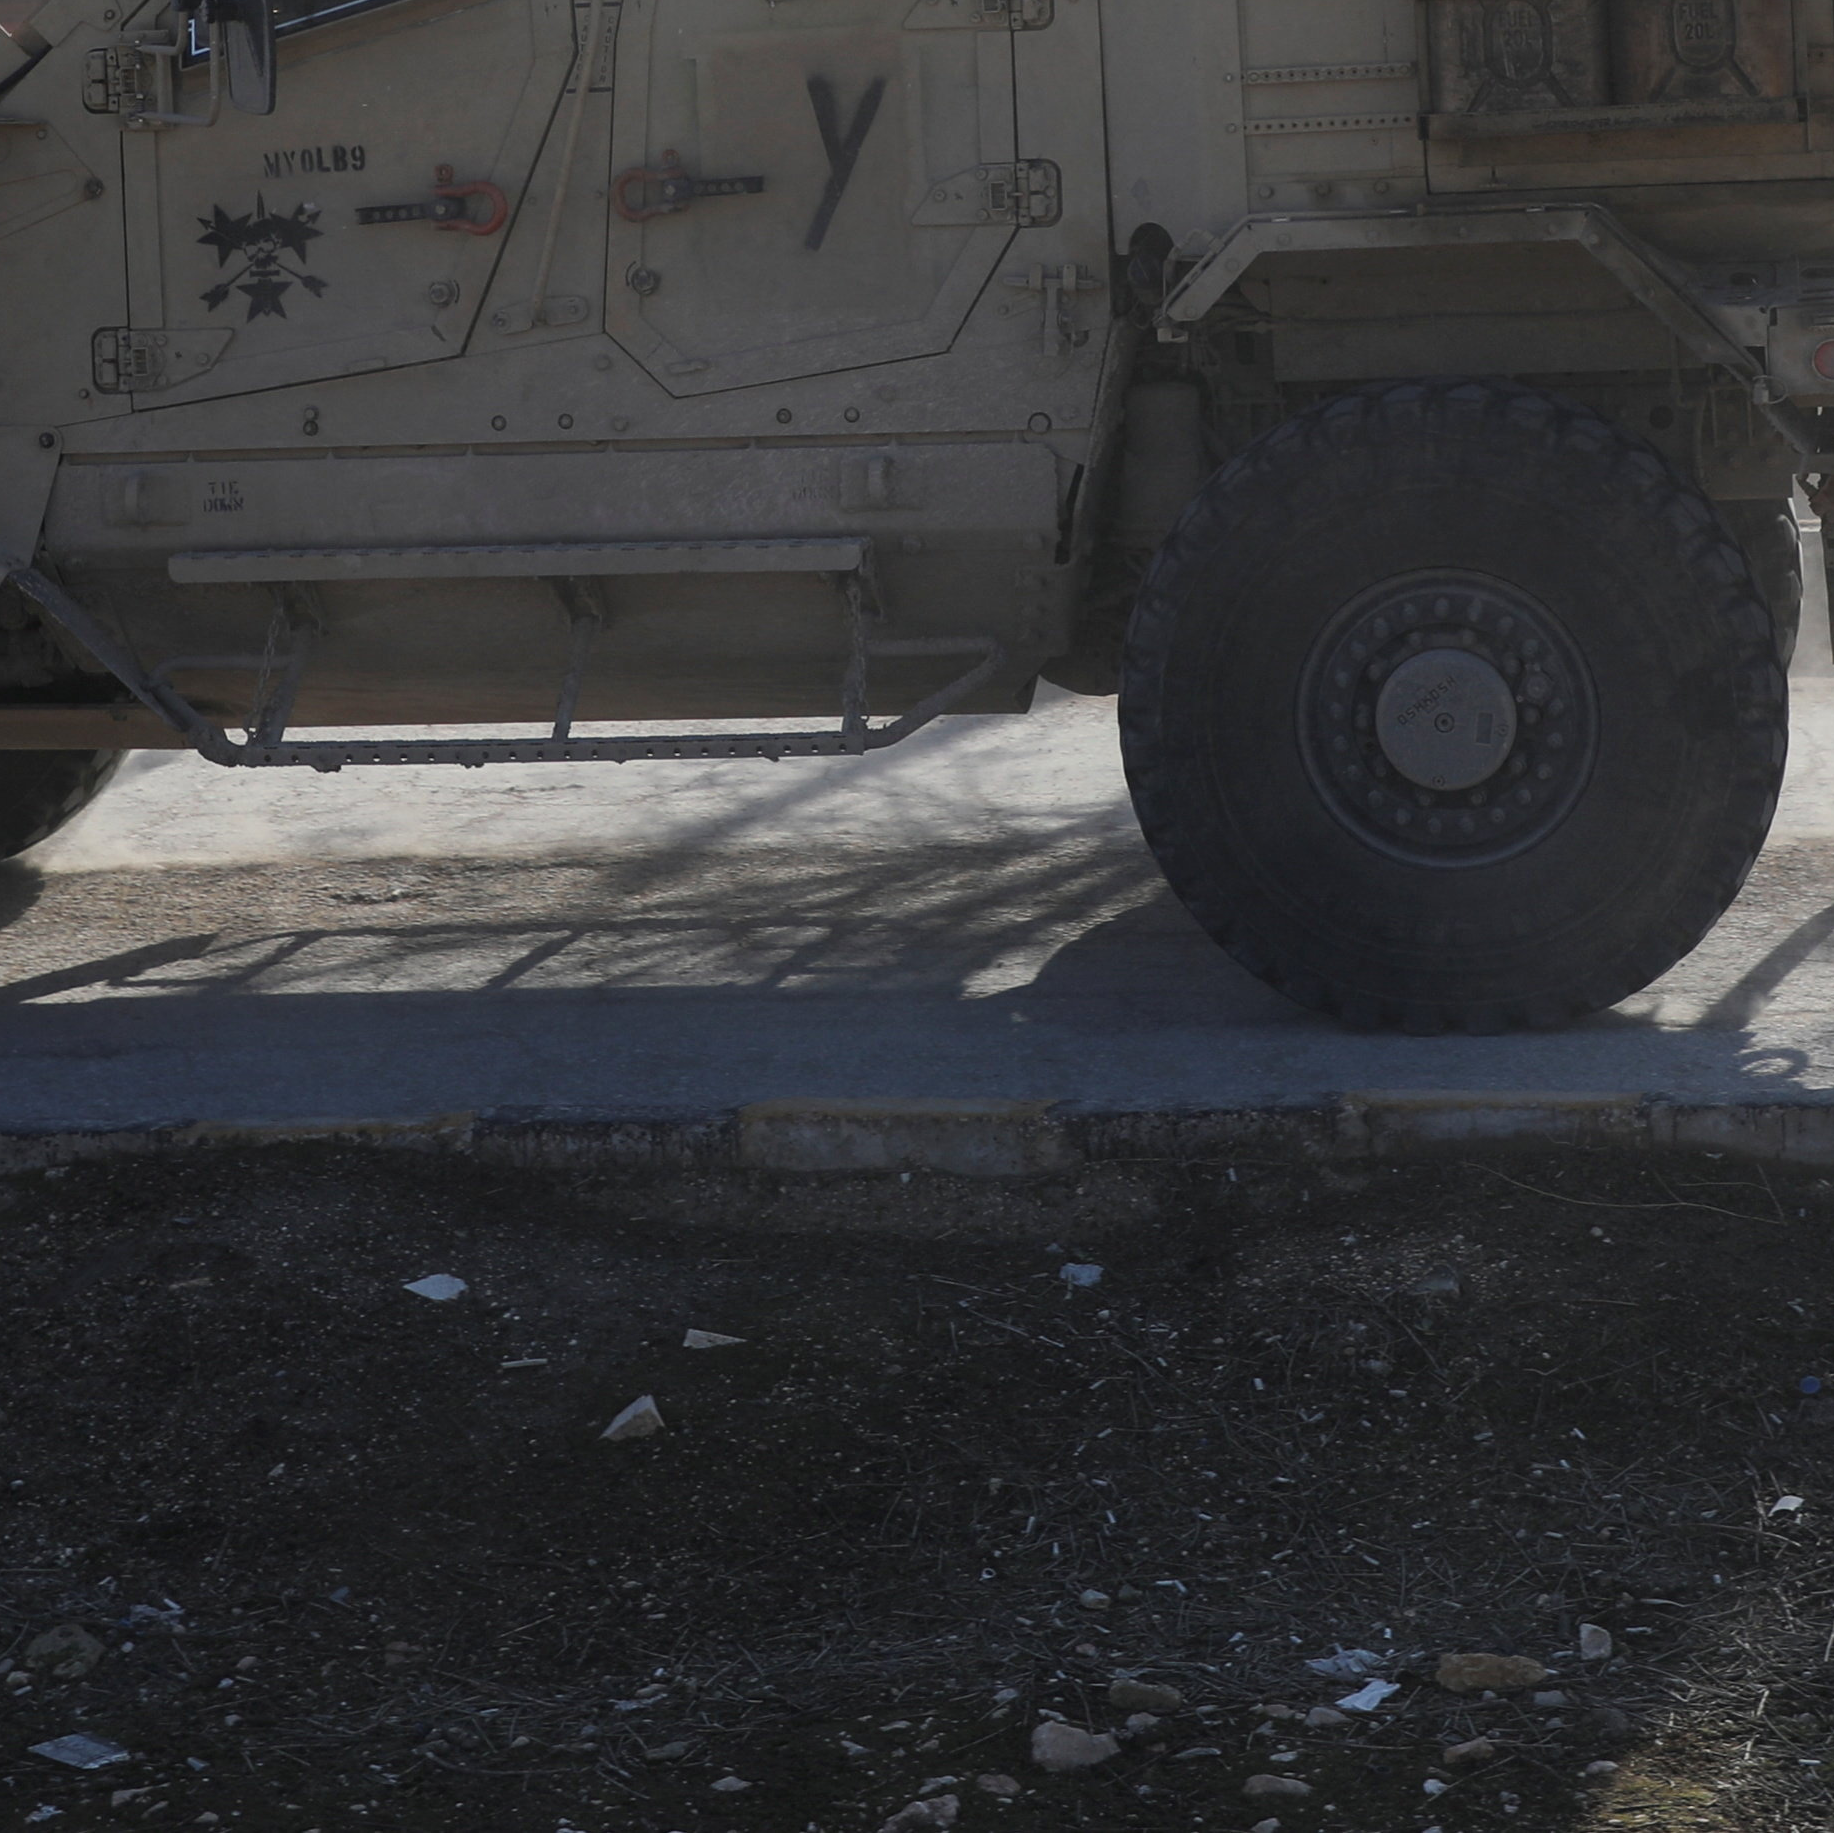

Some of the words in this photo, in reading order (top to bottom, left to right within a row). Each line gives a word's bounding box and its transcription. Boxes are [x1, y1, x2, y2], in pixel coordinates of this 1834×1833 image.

[1679, 1, 1718, 20] FUEL
[1684, 22, 1714, 41] 20L
[598, 15, 615, 84] CAUTION
[207, 480, 239, 495] TIE
[203, 497, 244, 513] DOWN
